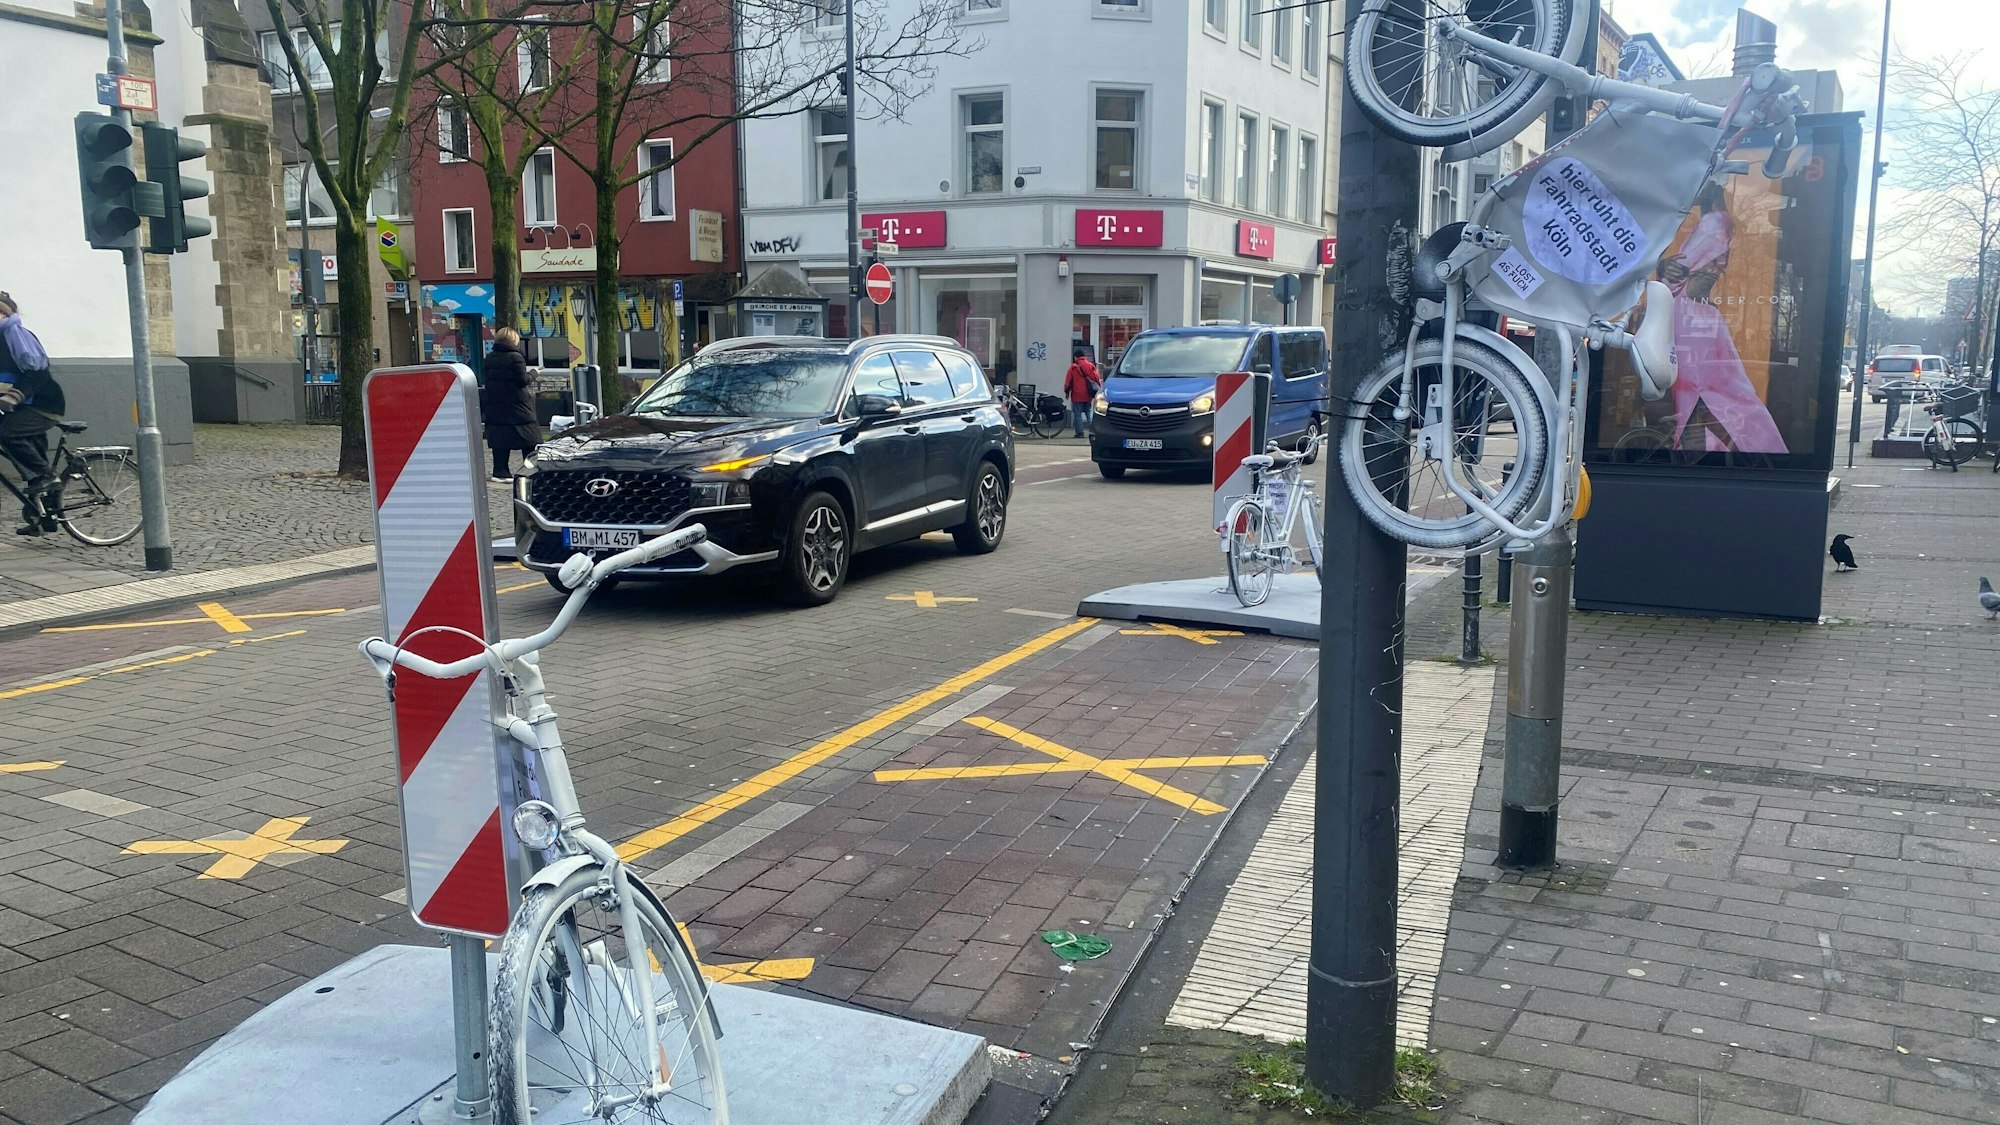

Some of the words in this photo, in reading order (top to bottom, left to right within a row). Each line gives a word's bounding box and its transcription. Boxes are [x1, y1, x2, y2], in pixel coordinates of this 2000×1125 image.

[1560, 163, 1591, 194] hier
[1587, 194, 1619, 228] ruht
[1613, 227, 1637, 253] die
[1539, 176, 1619, 274] Fahrradstadt
[1542, 219, 1572, 257] Köln
[536, 251, 584, 270] Saudade
[1498, 261, 1510, 273] AS
[1515, 264, 1536, 284] LOST
[1680, 295, 1795, 305] NINGER.COM
[1140, 440, 1149, 448] ZA
[1149, 440, 1162, 448] 415
[571, 530, 588, 545] BM
[595, 531, 611, 546] MI
[613, 532, 637, 546] 457
